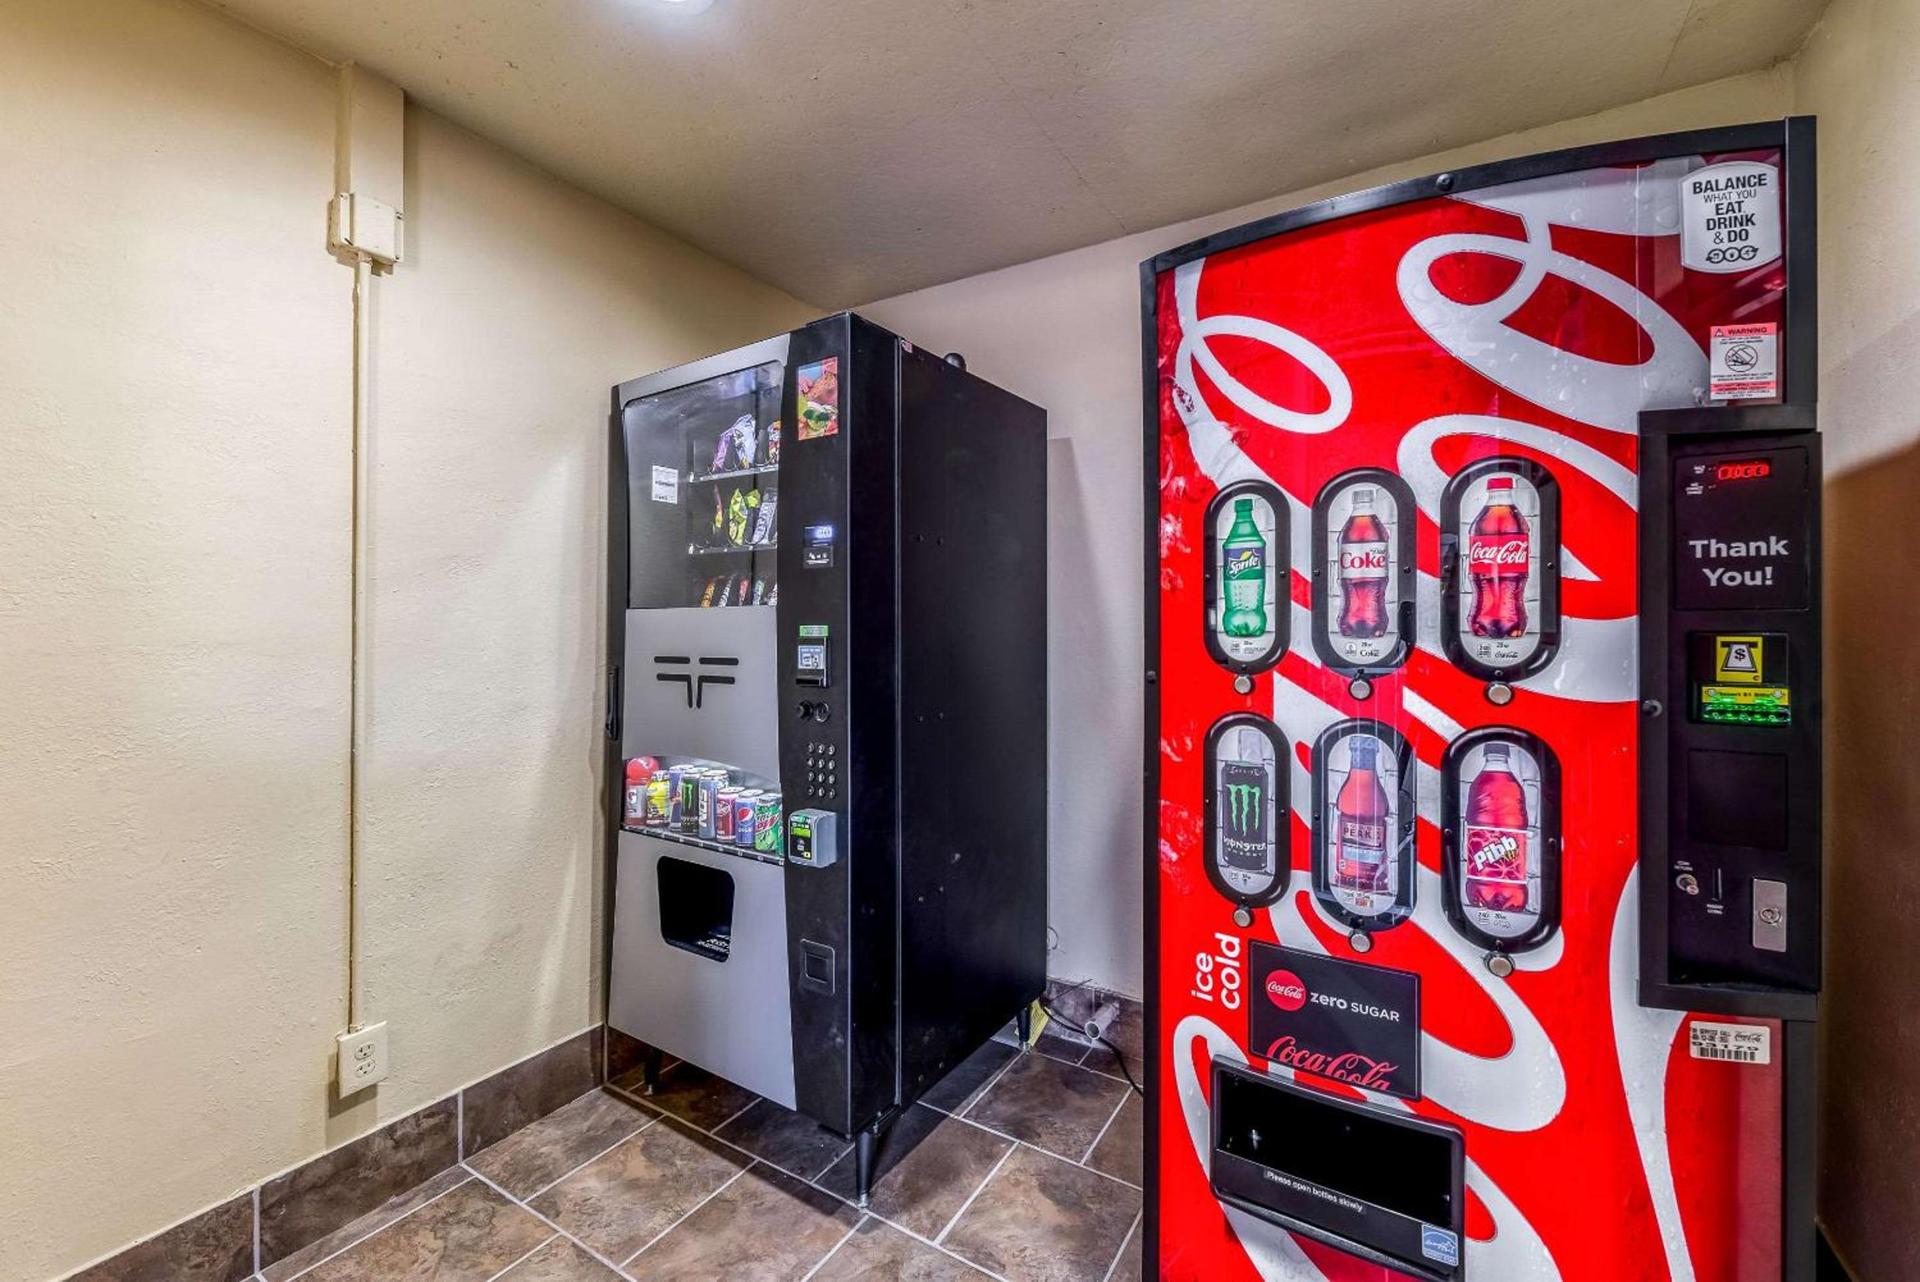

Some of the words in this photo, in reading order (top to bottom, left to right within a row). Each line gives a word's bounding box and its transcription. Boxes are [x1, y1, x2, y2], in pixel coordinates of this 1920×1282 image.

[1692, 173, 1768, 195] BALANCE
[1703, 191, 1733, 203] WHAT
[1736, 188, 1757, 199] YOU
[1706, 213, 1756, 231] DRINK
[1713, 231, 1725, 244] &
[1727, 228, 1749, 243] DO
[1727, 326, 1768, 335] WARNING
[1470, 540, 1528, 565] Coca-Cola
[1688, 535, 1790, 559] Thank
[1228, 555, 1260, 576] Sprite
[1340, 551, 1387, 570] Coke
[1702, 566, 1773, 587] You!
[1473, 835, 1518, 871] Pibb
[1191, 951, 1214, 1002] ice
[1214, 932, 1241, 1010] cold
[1267, 980, 1303, 1000] Coca-Cola
[1310, 992, 1348, 1010] zero
[1350, 1002, 1400, 1022] SUGAR
[1267, 1170, 1291, 1187] Please
[1292, 1181, 1311, 1194] open
[1312, 1187, 1337, 1203] bottles
[1338, 1198, 1363, 1213] slowly
